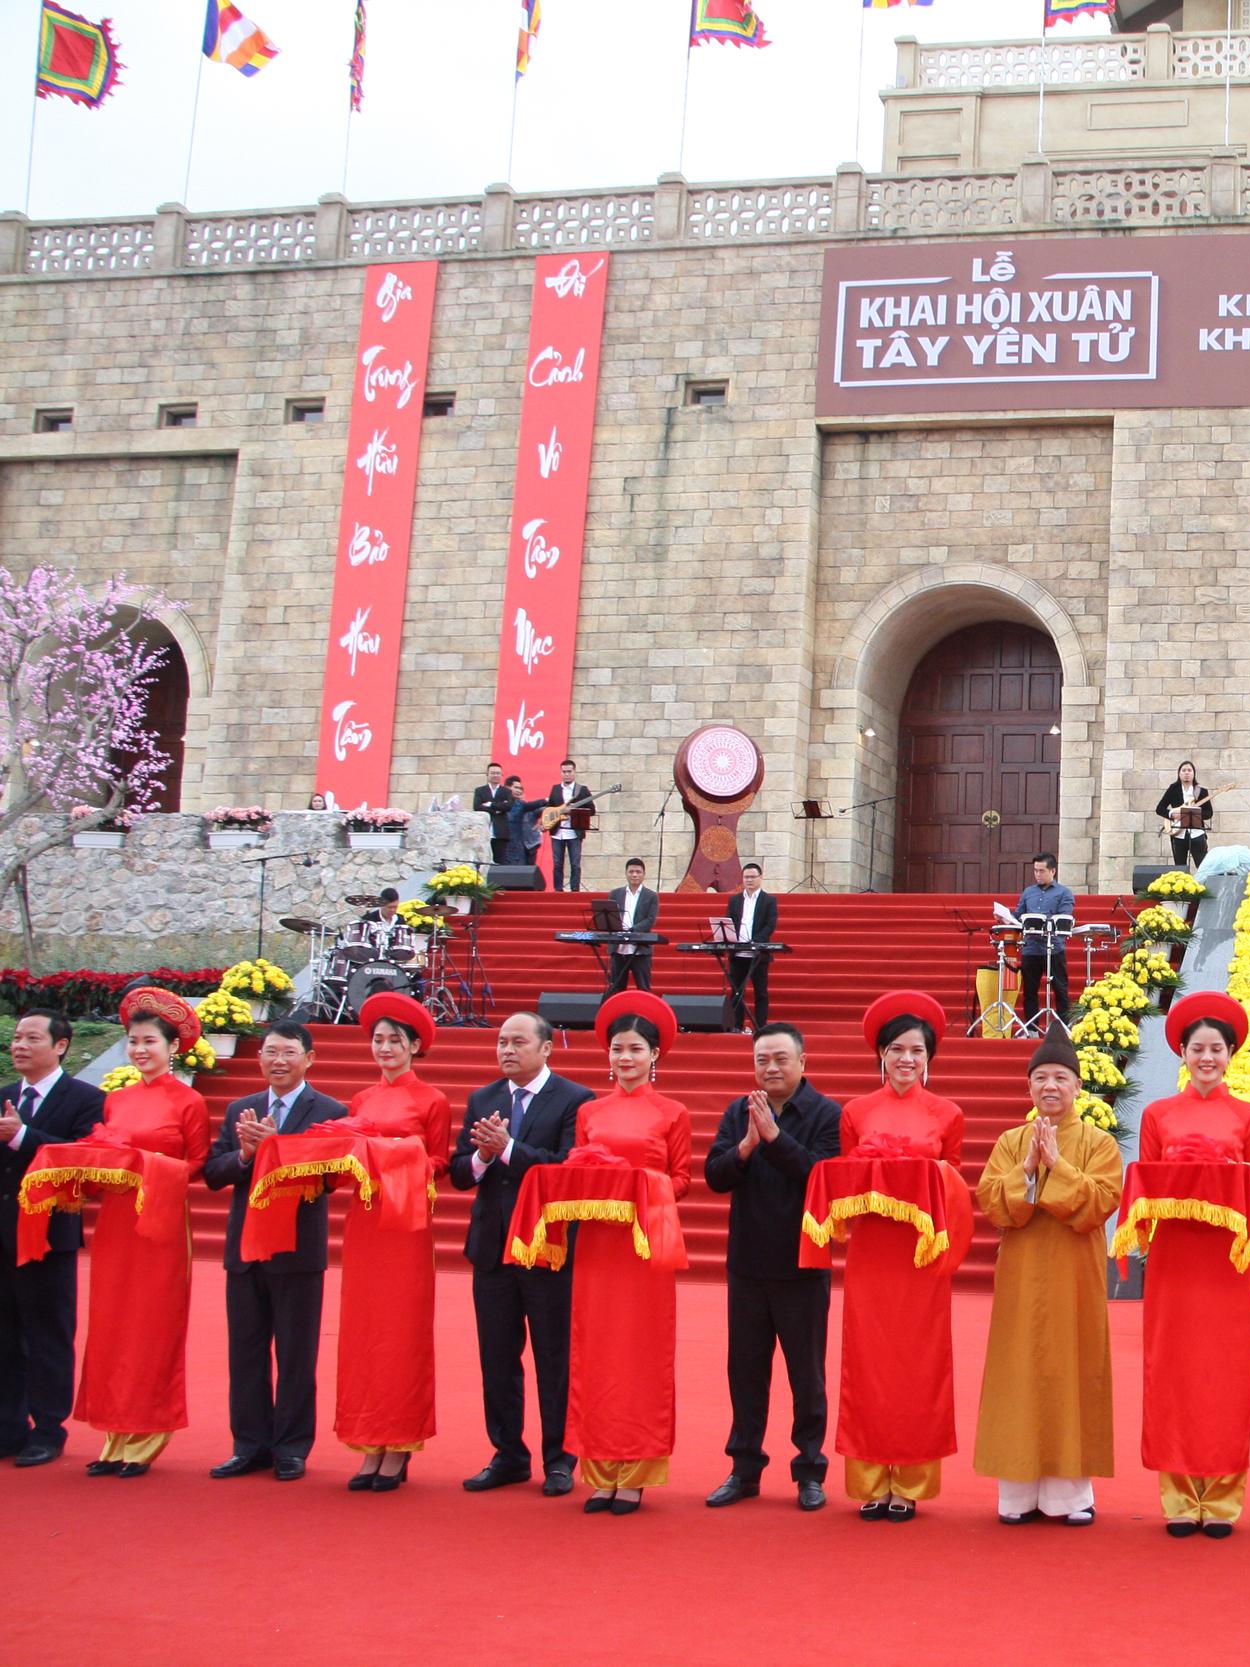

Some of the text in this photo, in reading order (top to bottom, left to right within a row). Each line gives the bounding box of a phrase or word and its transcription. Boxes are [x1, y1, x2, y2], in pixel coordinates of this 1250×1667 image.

[972, 251, 1016, 282] Lễ
[859, 285, 1132, 330] KHAI HỘI XUÂN
[856, 322, 1136, 369] TÂY YÊN TỬ
[348, 521, 391, 567] Bảo
[521, 518, 560, 579] Tâm
[514, 608, 556, 675] Mạc
[372, 967, 398, 976] YAMAHA
